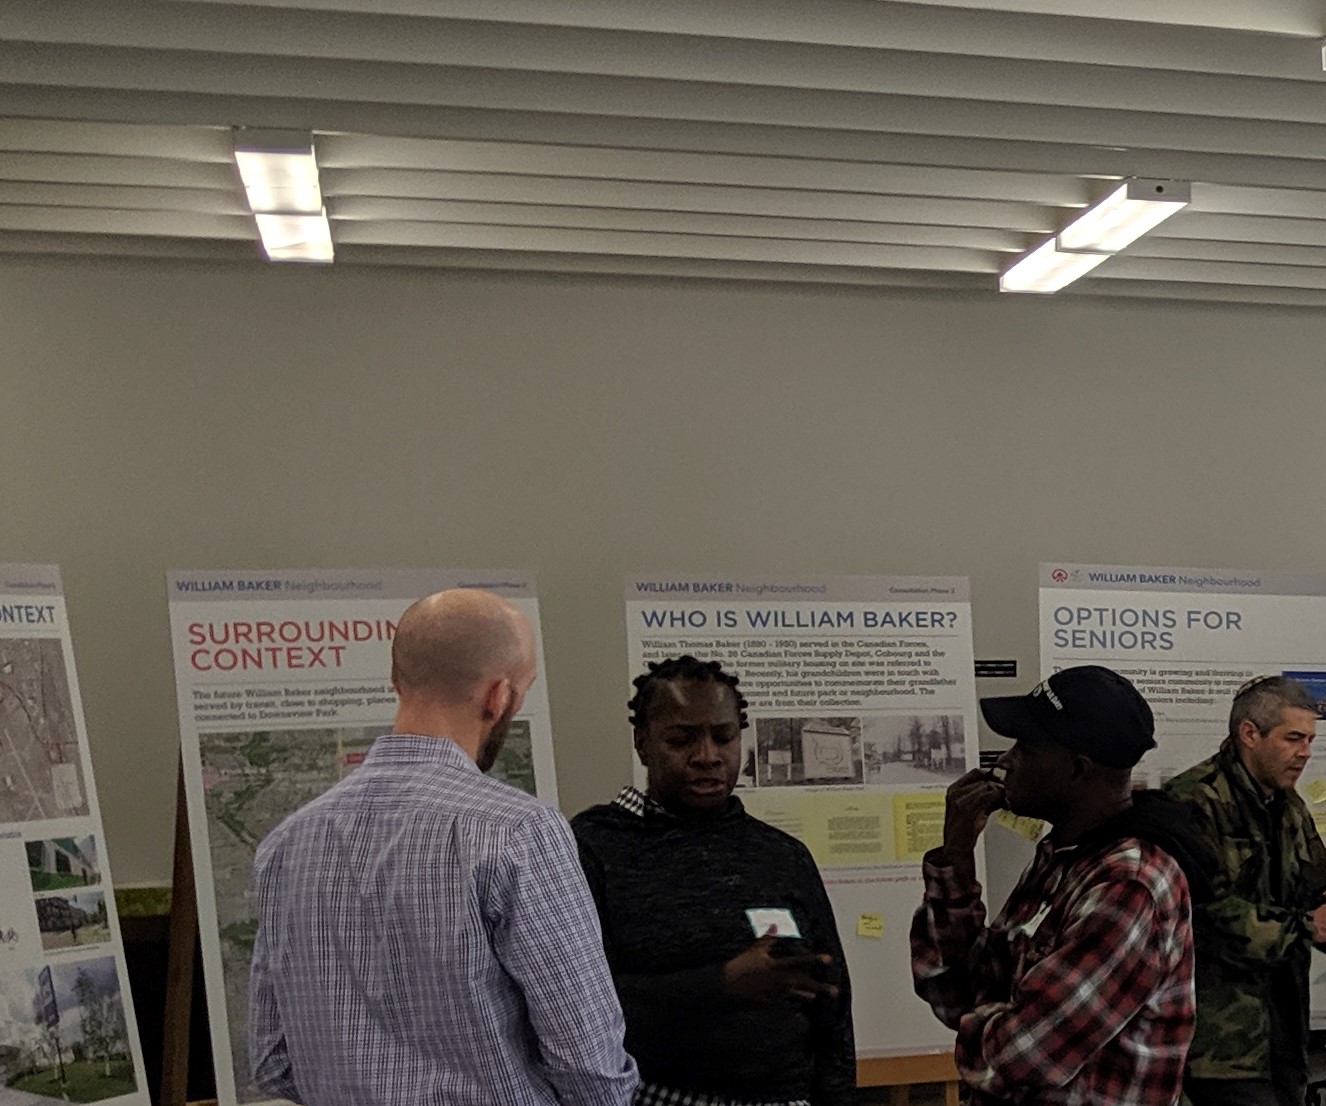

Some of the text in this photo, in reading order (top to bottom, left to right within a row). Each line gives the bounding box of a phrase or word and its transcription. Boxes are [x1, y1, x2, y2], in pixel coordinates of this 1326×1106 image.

[176, 580, 383, 594] WILLIAM BAKER Neighbourhood
[636, 582, 826, 595] WILLIAM BAKER Neighbourhood
[1089, 573, 1261, 588] WILLIAM BAKER Neighbourhood
[641, 610, 958, 629] WHO IS WILLIAM BAKER?
[1053, 606, 1242, 631] OPTIONS FOR
[857, 640, 897, 648] Canadian
[1053, 628, 1174, 651] SENIORS
[190, 645, 347, 672] CONTEXT
